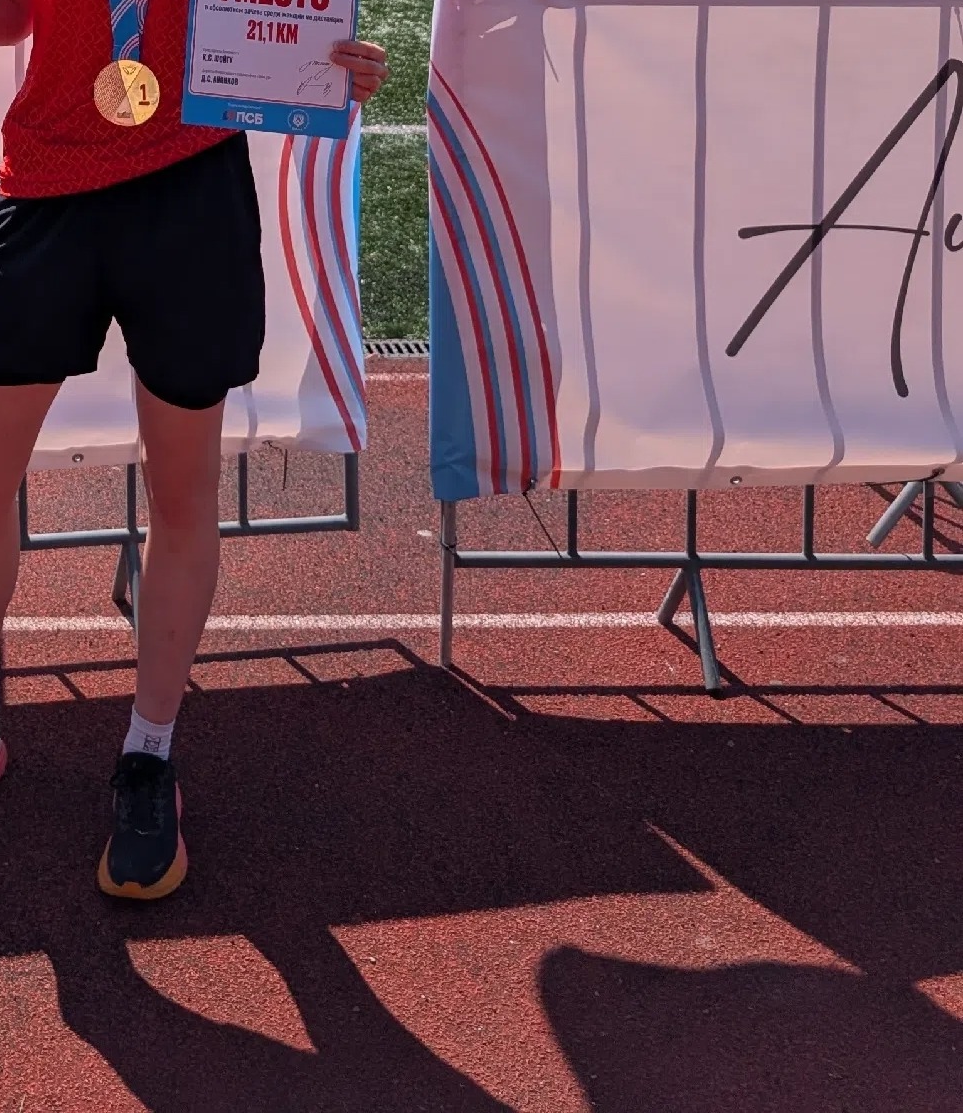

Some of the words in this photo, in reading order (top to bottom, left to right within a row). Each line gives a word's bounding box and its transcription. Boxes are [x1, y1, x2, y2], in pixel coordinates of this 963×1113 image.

[246, 19, 273, 44] 21,1
[275, 21, 299, 45] КМ
[139, 83, 147, 101] 1
[236, 111, 264, 125] ПСБ
